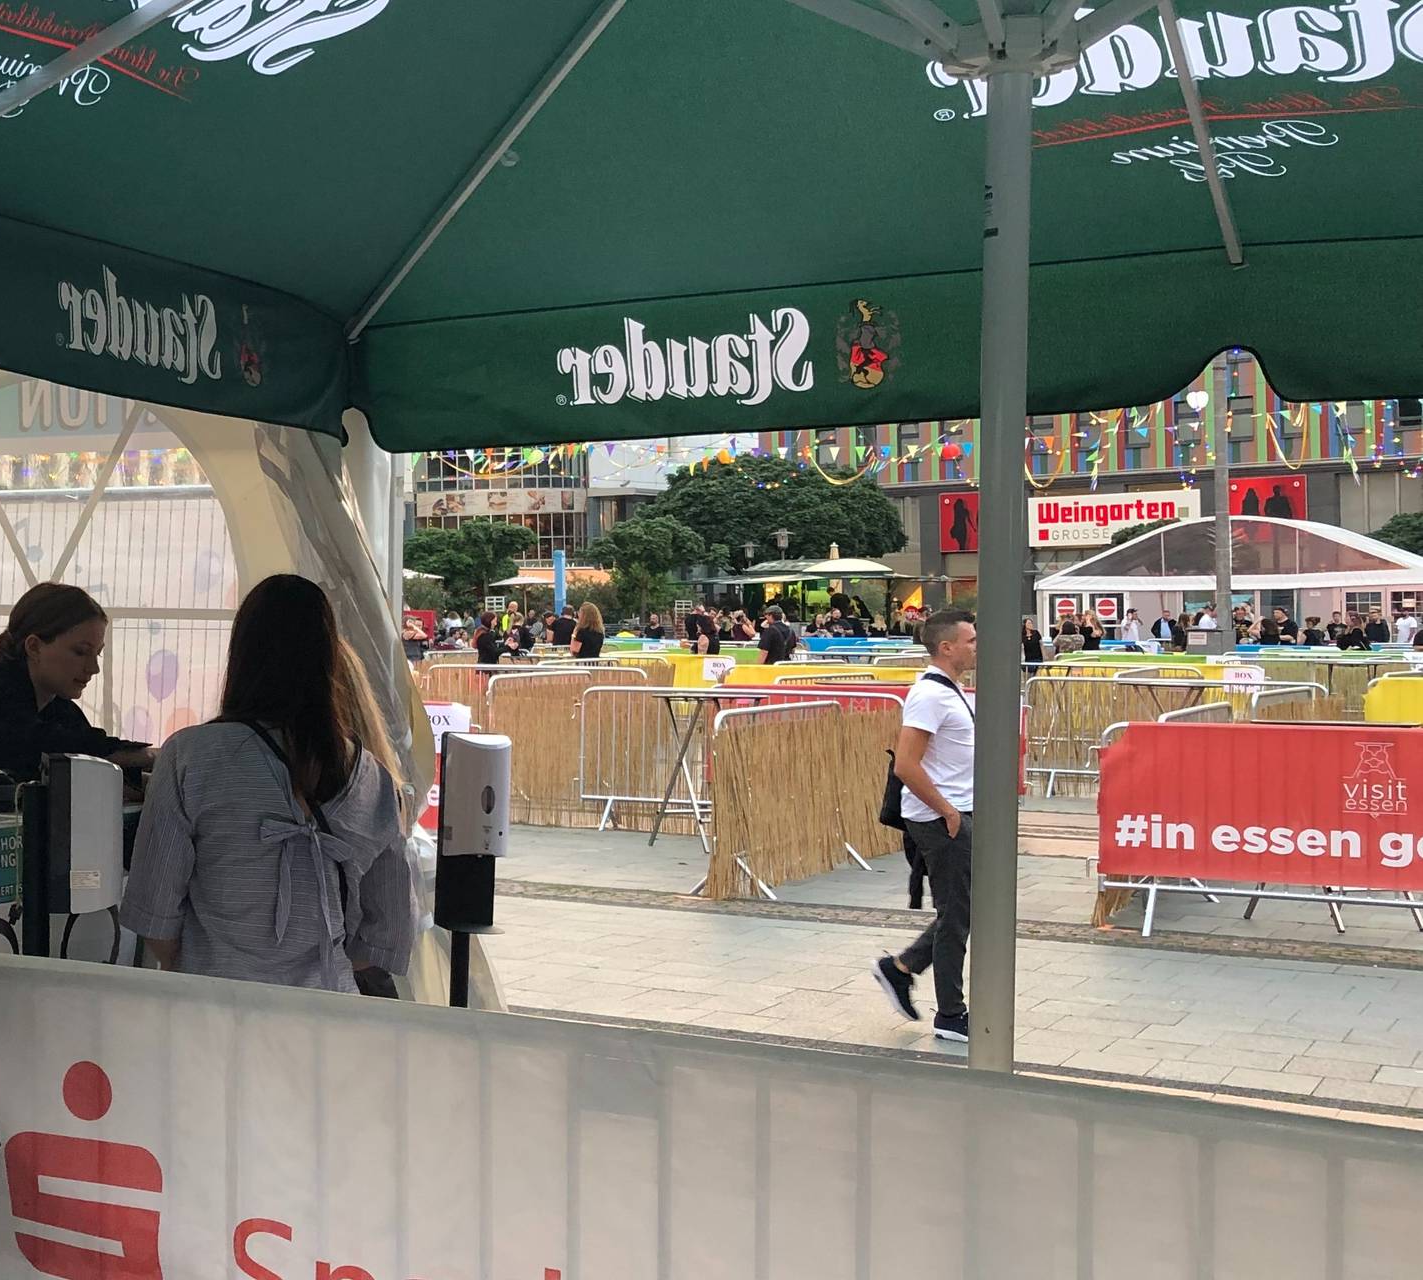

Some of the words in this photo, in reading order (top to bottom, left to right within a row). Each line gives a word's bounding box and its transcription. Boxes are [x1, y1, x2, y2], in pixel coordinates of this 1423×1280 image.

[1038, 499, 1175, 527] Weingarten
[1051, 527, 1111, 541] GROSSE
[1234, 671, 1254, 680] BOX
[1343, 778, 1408, 801] visit
[1345, 798, 1408, 812] essen
[1115, 814, 1196, 851] #in
[1211, 826, 1362, 859] essen
[1379, 832, 1423, 868] g
